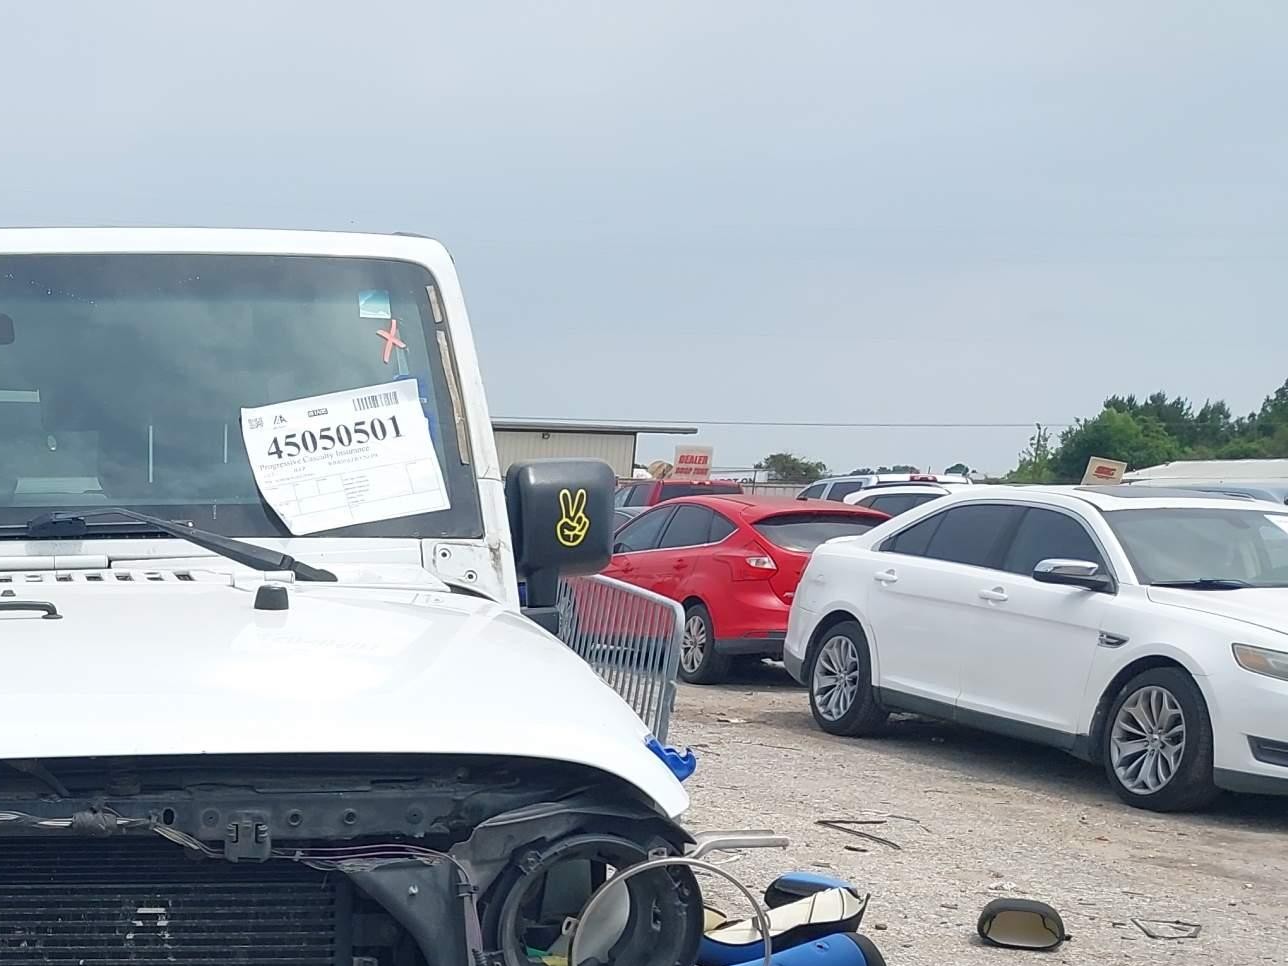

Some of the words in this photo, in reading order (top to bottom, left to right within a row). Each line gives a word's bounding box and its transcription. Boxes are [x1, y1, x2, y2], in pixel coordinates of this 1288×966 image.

[266, 414, 404, 460] 45050501
[259, 458, 302, 472] Progressive
[336, 445, 370, 458] Insurance
[678, 454, 709, 465] DEALER
